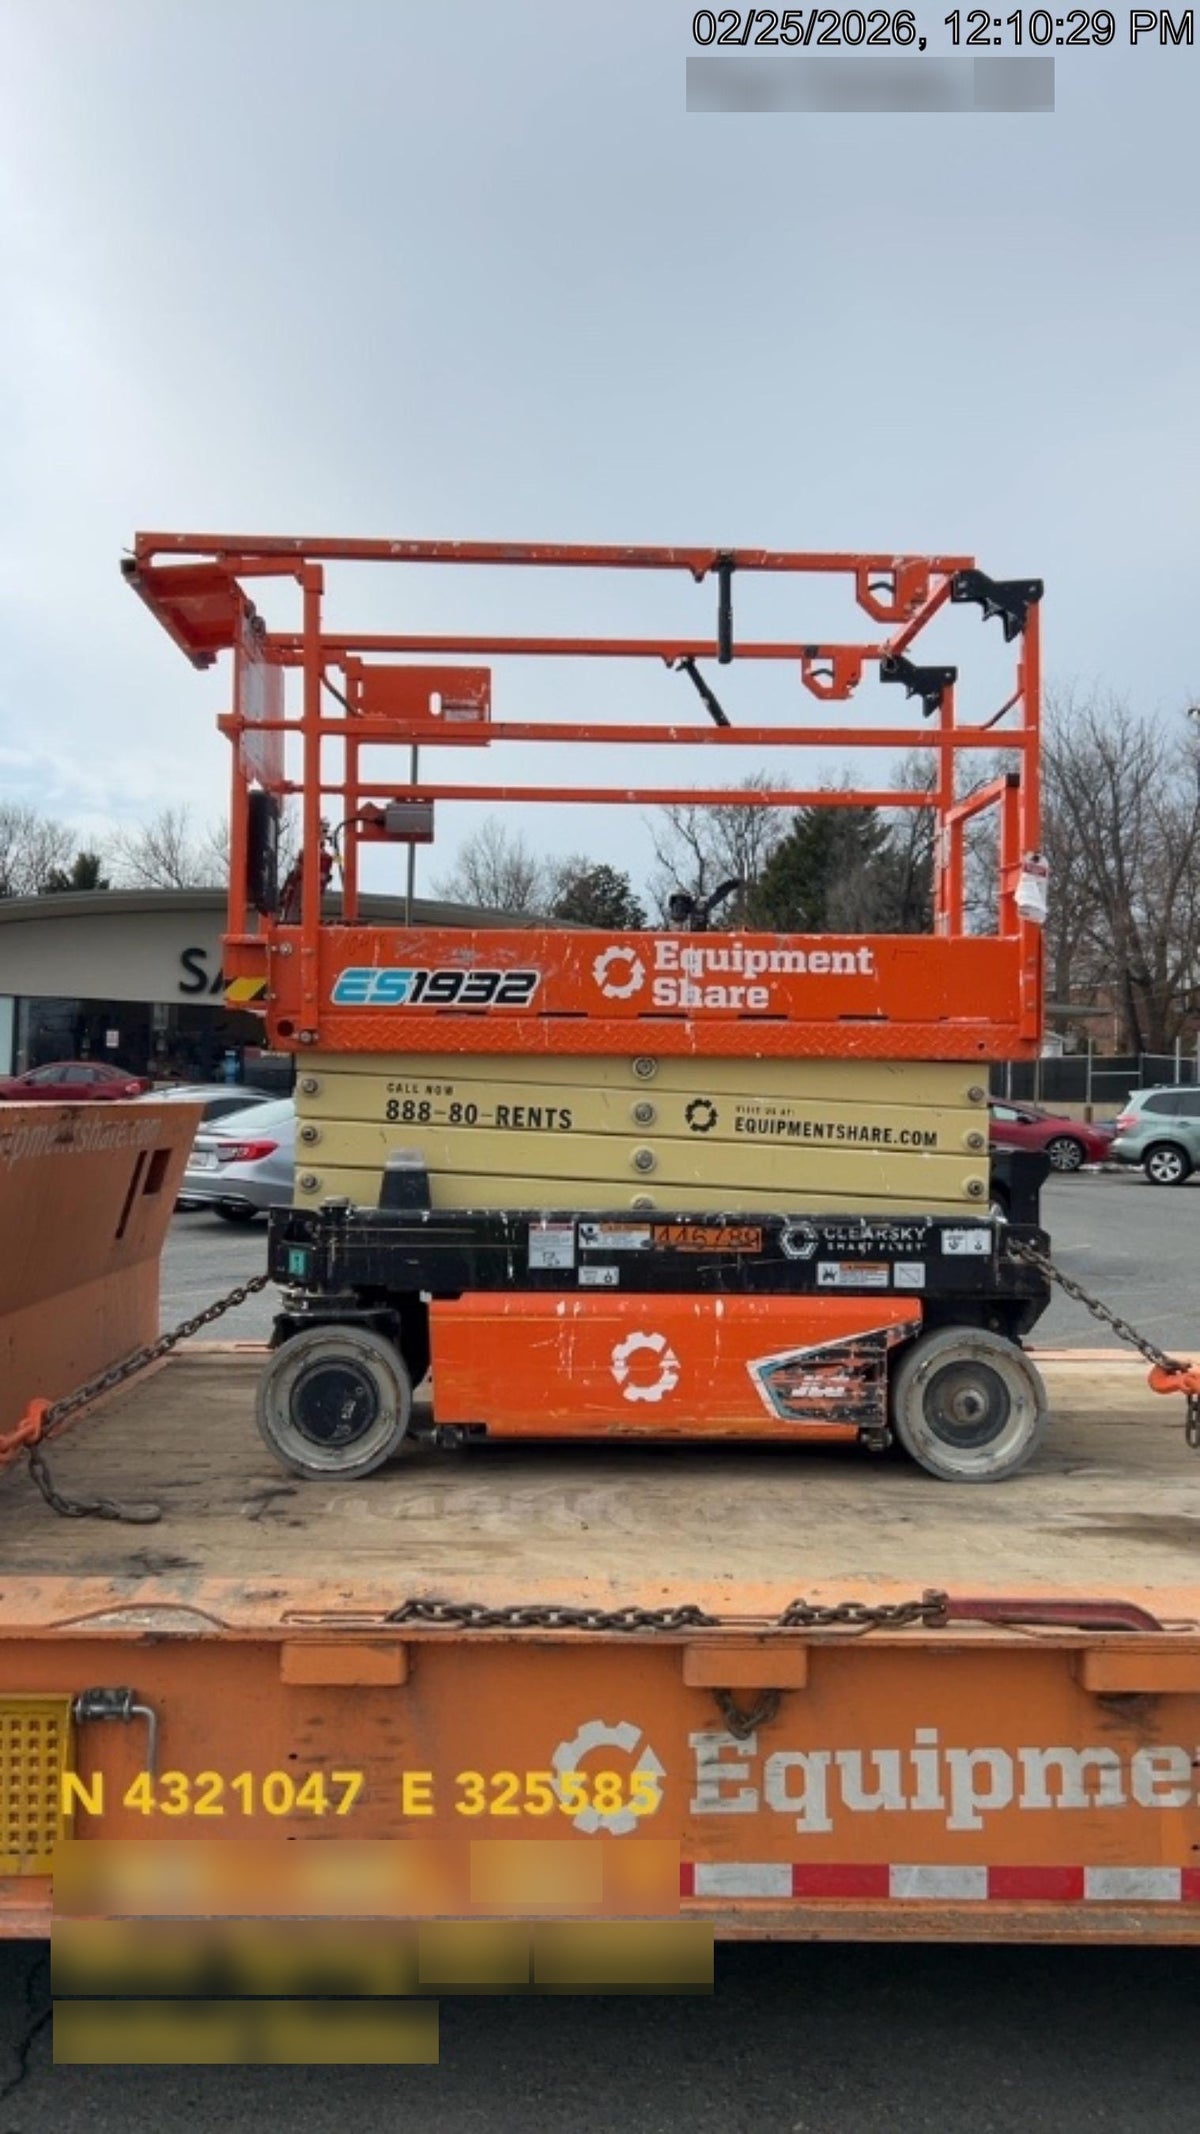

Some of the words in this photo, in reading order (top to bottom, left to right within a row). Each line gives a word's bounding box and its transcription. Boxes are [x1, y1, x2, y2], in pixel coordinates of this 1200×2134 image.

[653, 940, 874, 980] Equipment
[331, 967, 541, 1008] ES1932
[652, 977, 770, 1009] Share
[386, 1082, 420, 1095] CALL
[424, 1085, 454, 1096] NOW
[386, 1099, 573, 1130] 888-80-RENTS
[735, 1116, 938, 1147] EQUIPMENTSHARE.COM
[823, 1226, 926, 1241] CLEARSKY
[827, 1241, 873, 1252] SMART
[879, 1241, 922, 1252] FLEET
[688, 1727, 1200, 1833] Equipme
